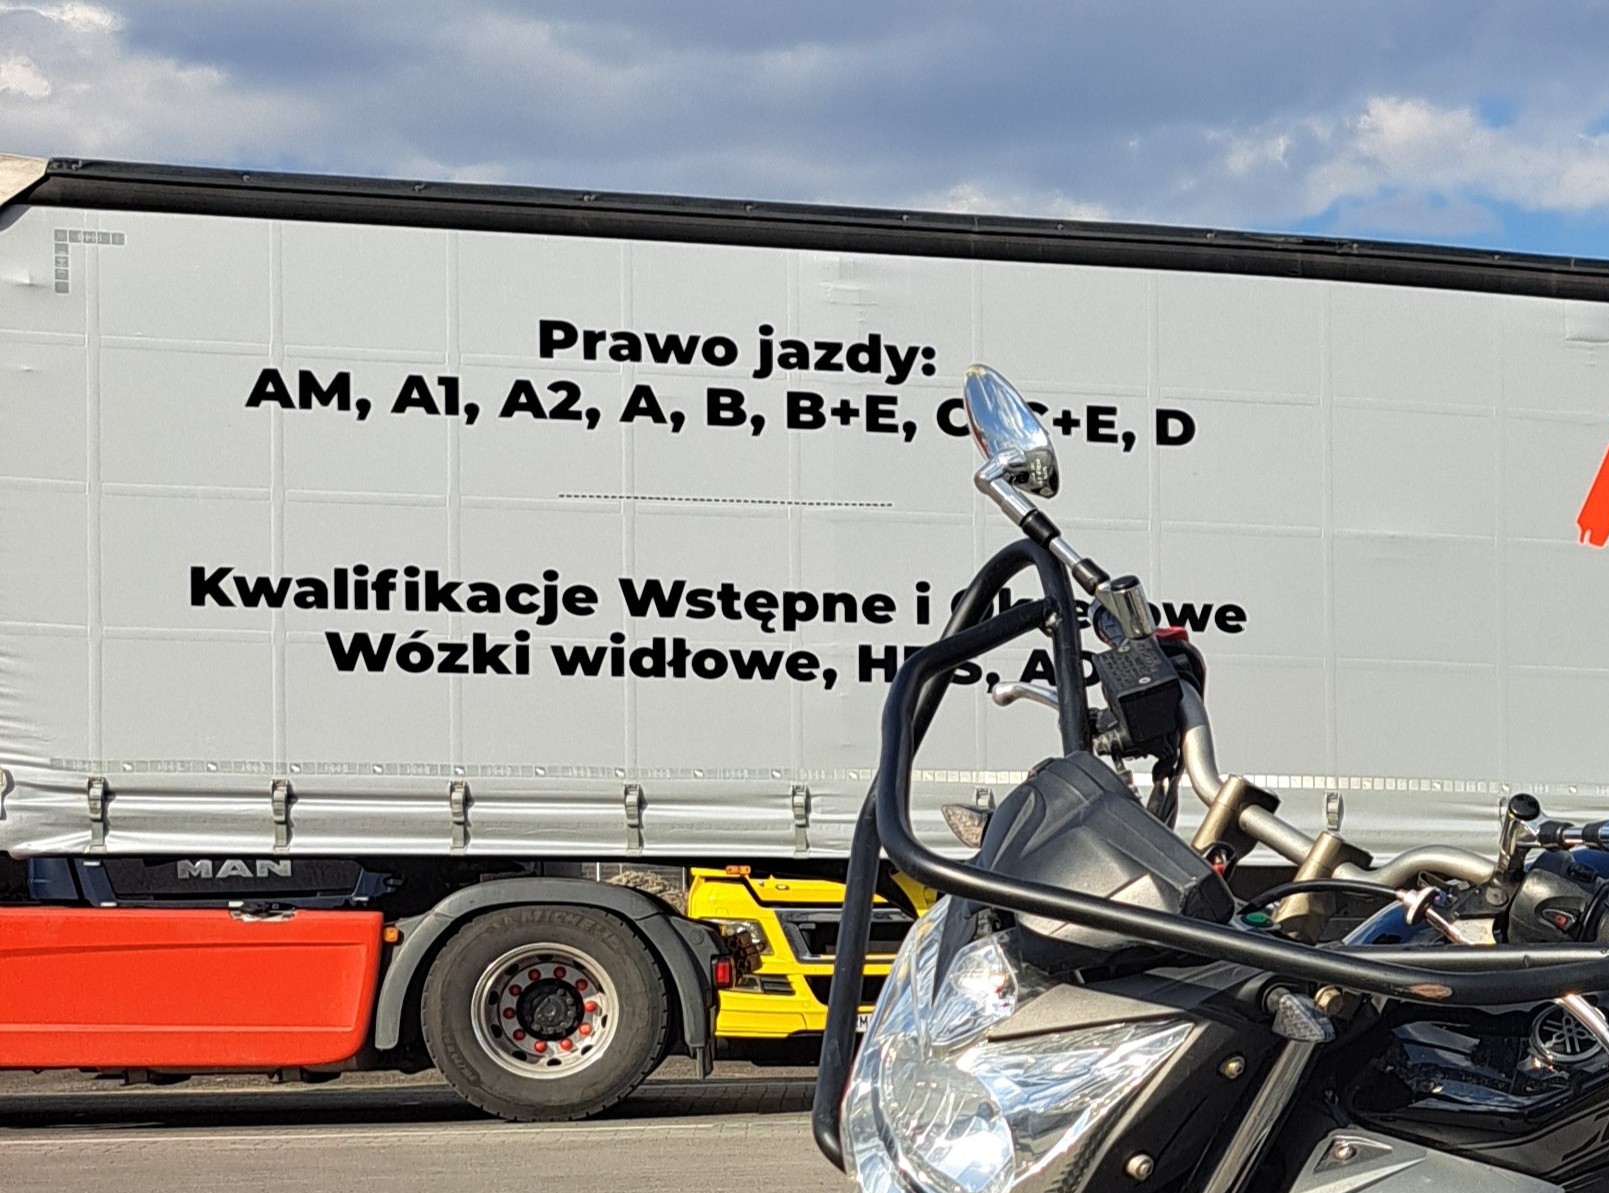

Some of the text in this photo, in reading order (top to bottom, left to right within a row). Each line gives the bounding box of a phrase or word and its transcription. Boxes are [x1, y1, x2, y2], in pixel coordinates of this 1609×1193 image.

[540, 319, 936, 387] Prawo jazdy:
[246, 368, 372, 421] AM,
[391, 374, 480, 425] A1,
[500, 379, 601, 430] A2,
[620, 384, 686, 433] A,
[706, 388, 766, 437] B,
[786, 392, 917, 443] B+E,
[1025, 401, 1136, 452] +E,
[1156, 408, 1196, 446] D
[190, 564, 599, 626] Kwalifikacje
[618, 578, 897, 634] Wstępne
[915, 581, 931, 625] i
[325, 629, 531, 676] Wózki
[550, 629, 838, 690] widłowe,
[859, 644, 1000, 694] HS,
[177, 859, 292, 879] MAN
